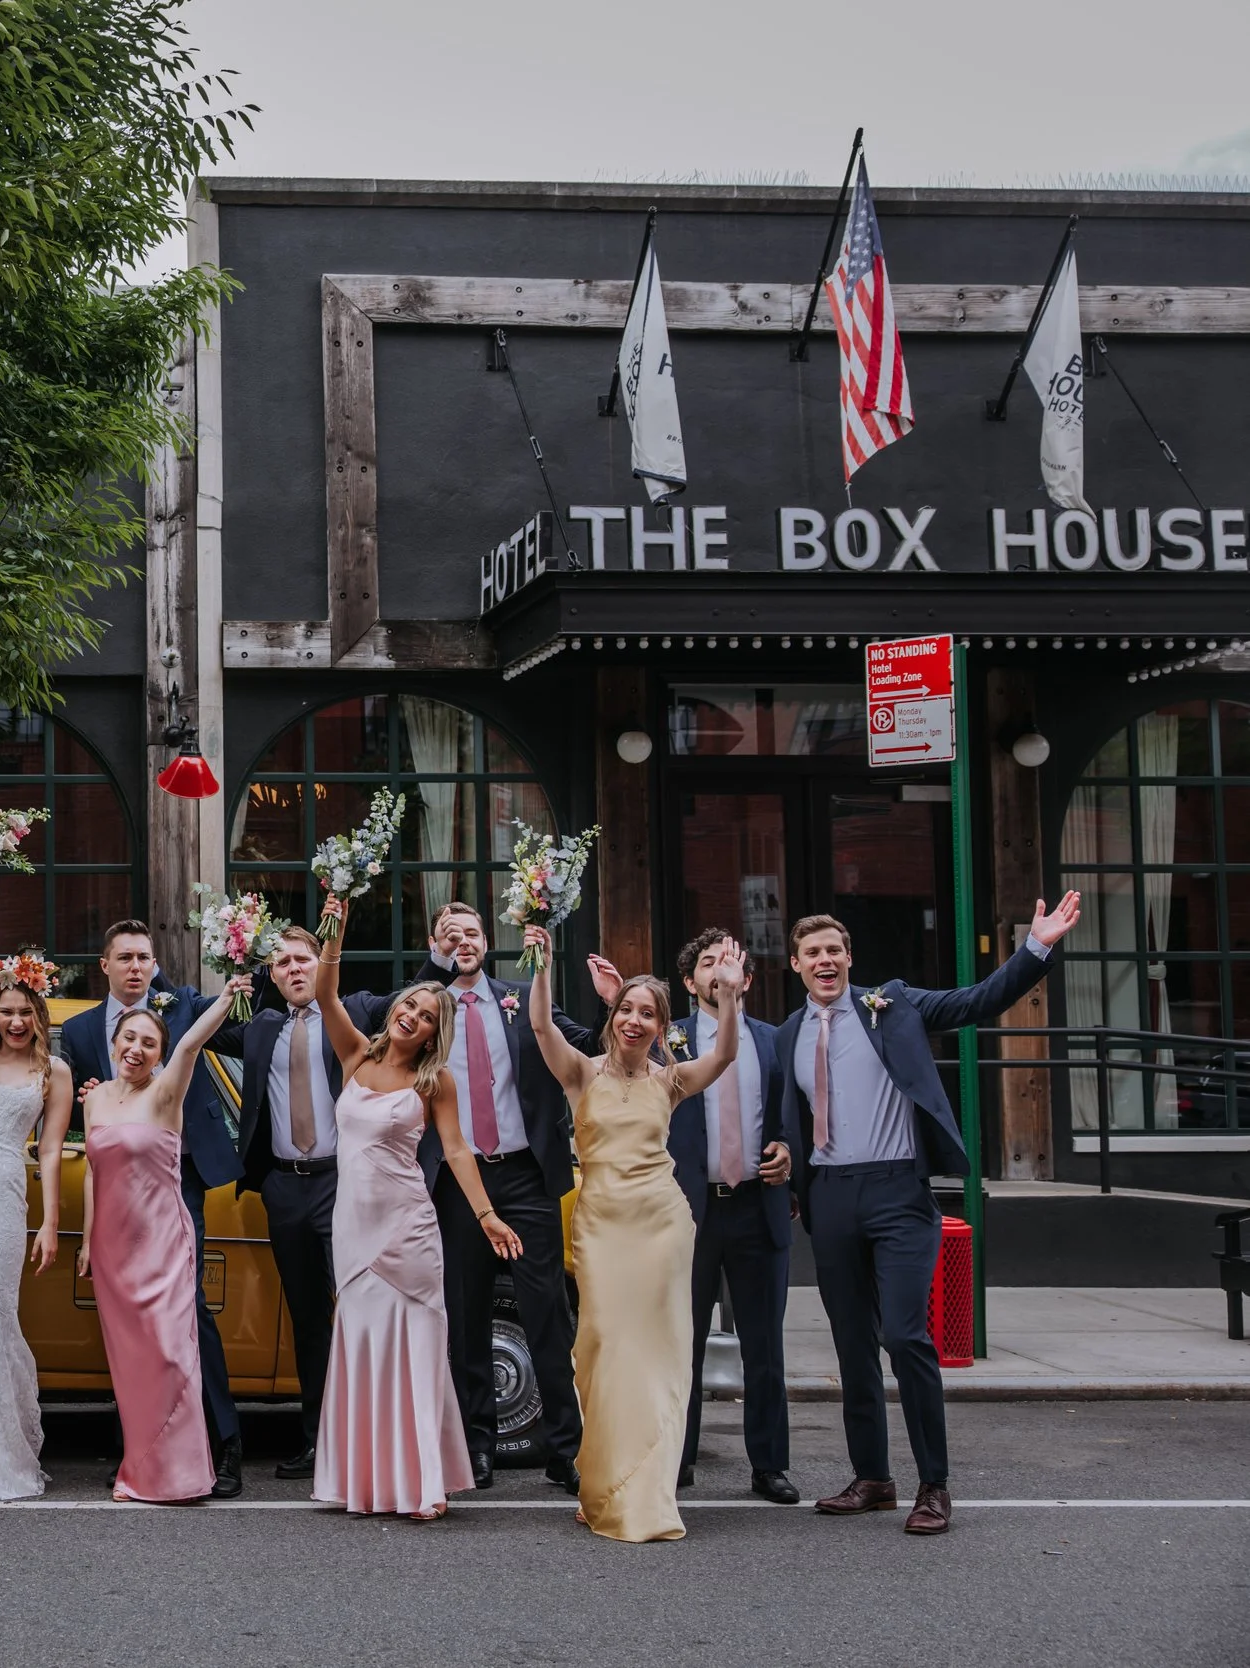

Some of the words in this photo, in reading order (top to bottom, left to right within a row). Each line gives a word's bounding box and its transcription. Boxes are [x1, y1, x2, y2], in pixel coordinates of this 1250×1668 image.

[569, 505, 729, 570] THE
[780, 507, 941, 571] BOX
[992, 507, 1248, 571] HOUSE
[480, 511, 547, 615] HOTEL
[871, 649, 885, 661] NO
[887, 642, 938, 660] STANDING
[871, 663, 892, 674] Hotel
[871, 674, 901, 686] Loading
[903, 672, 923, 683] Zone
[897, 708, 922, 716] Monday
[898, 716, 927, 726] Thursday
